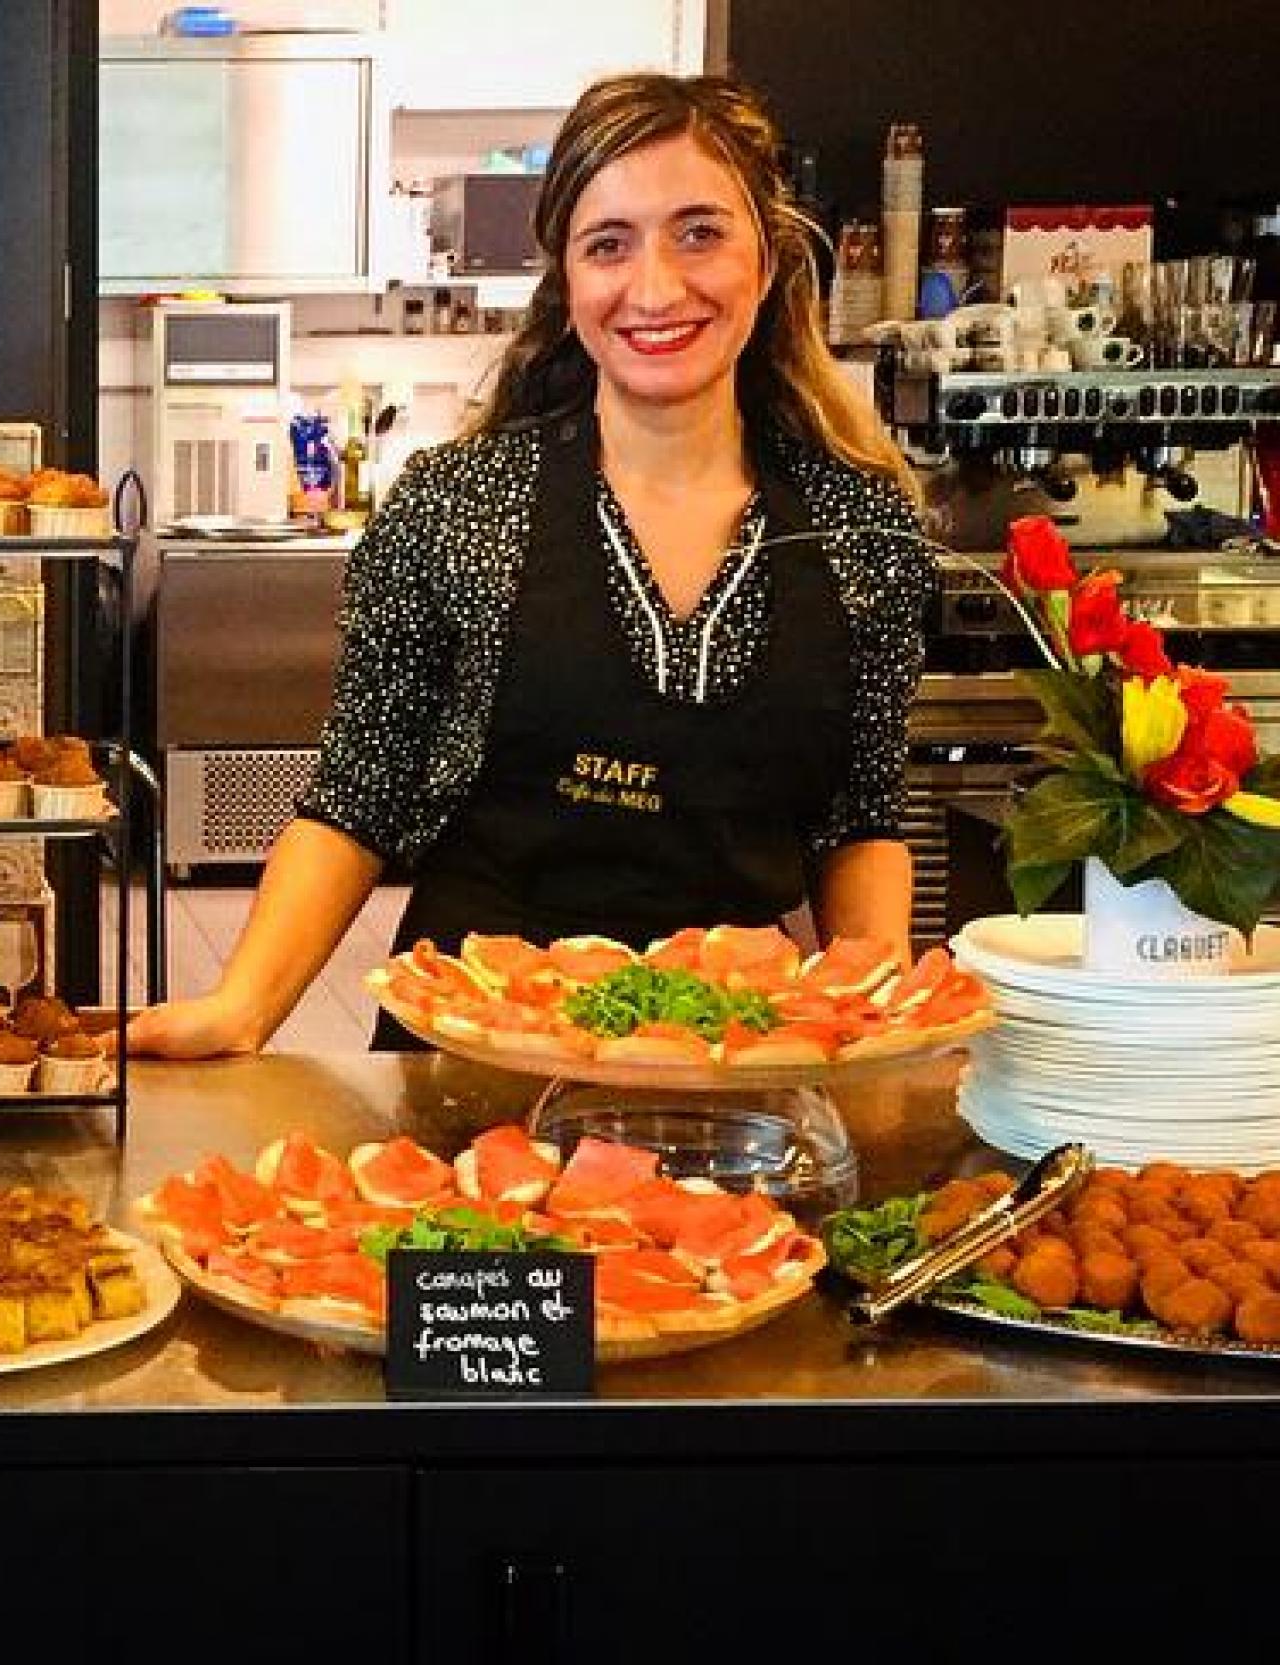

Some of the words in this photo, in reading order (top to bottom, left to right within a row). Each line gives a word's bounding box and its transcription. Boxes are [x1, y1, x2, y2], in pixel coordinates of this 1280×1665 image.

[573, 754, 659, 788] STAFF
[526, 1268, 563, 1290] au
[420, 1300, 530, 1324] saumon
[540, 1289, 574, 1322] et
[413, 1327, 540, 1369] fromage
[460, 1354, 543, 1386] blanc
